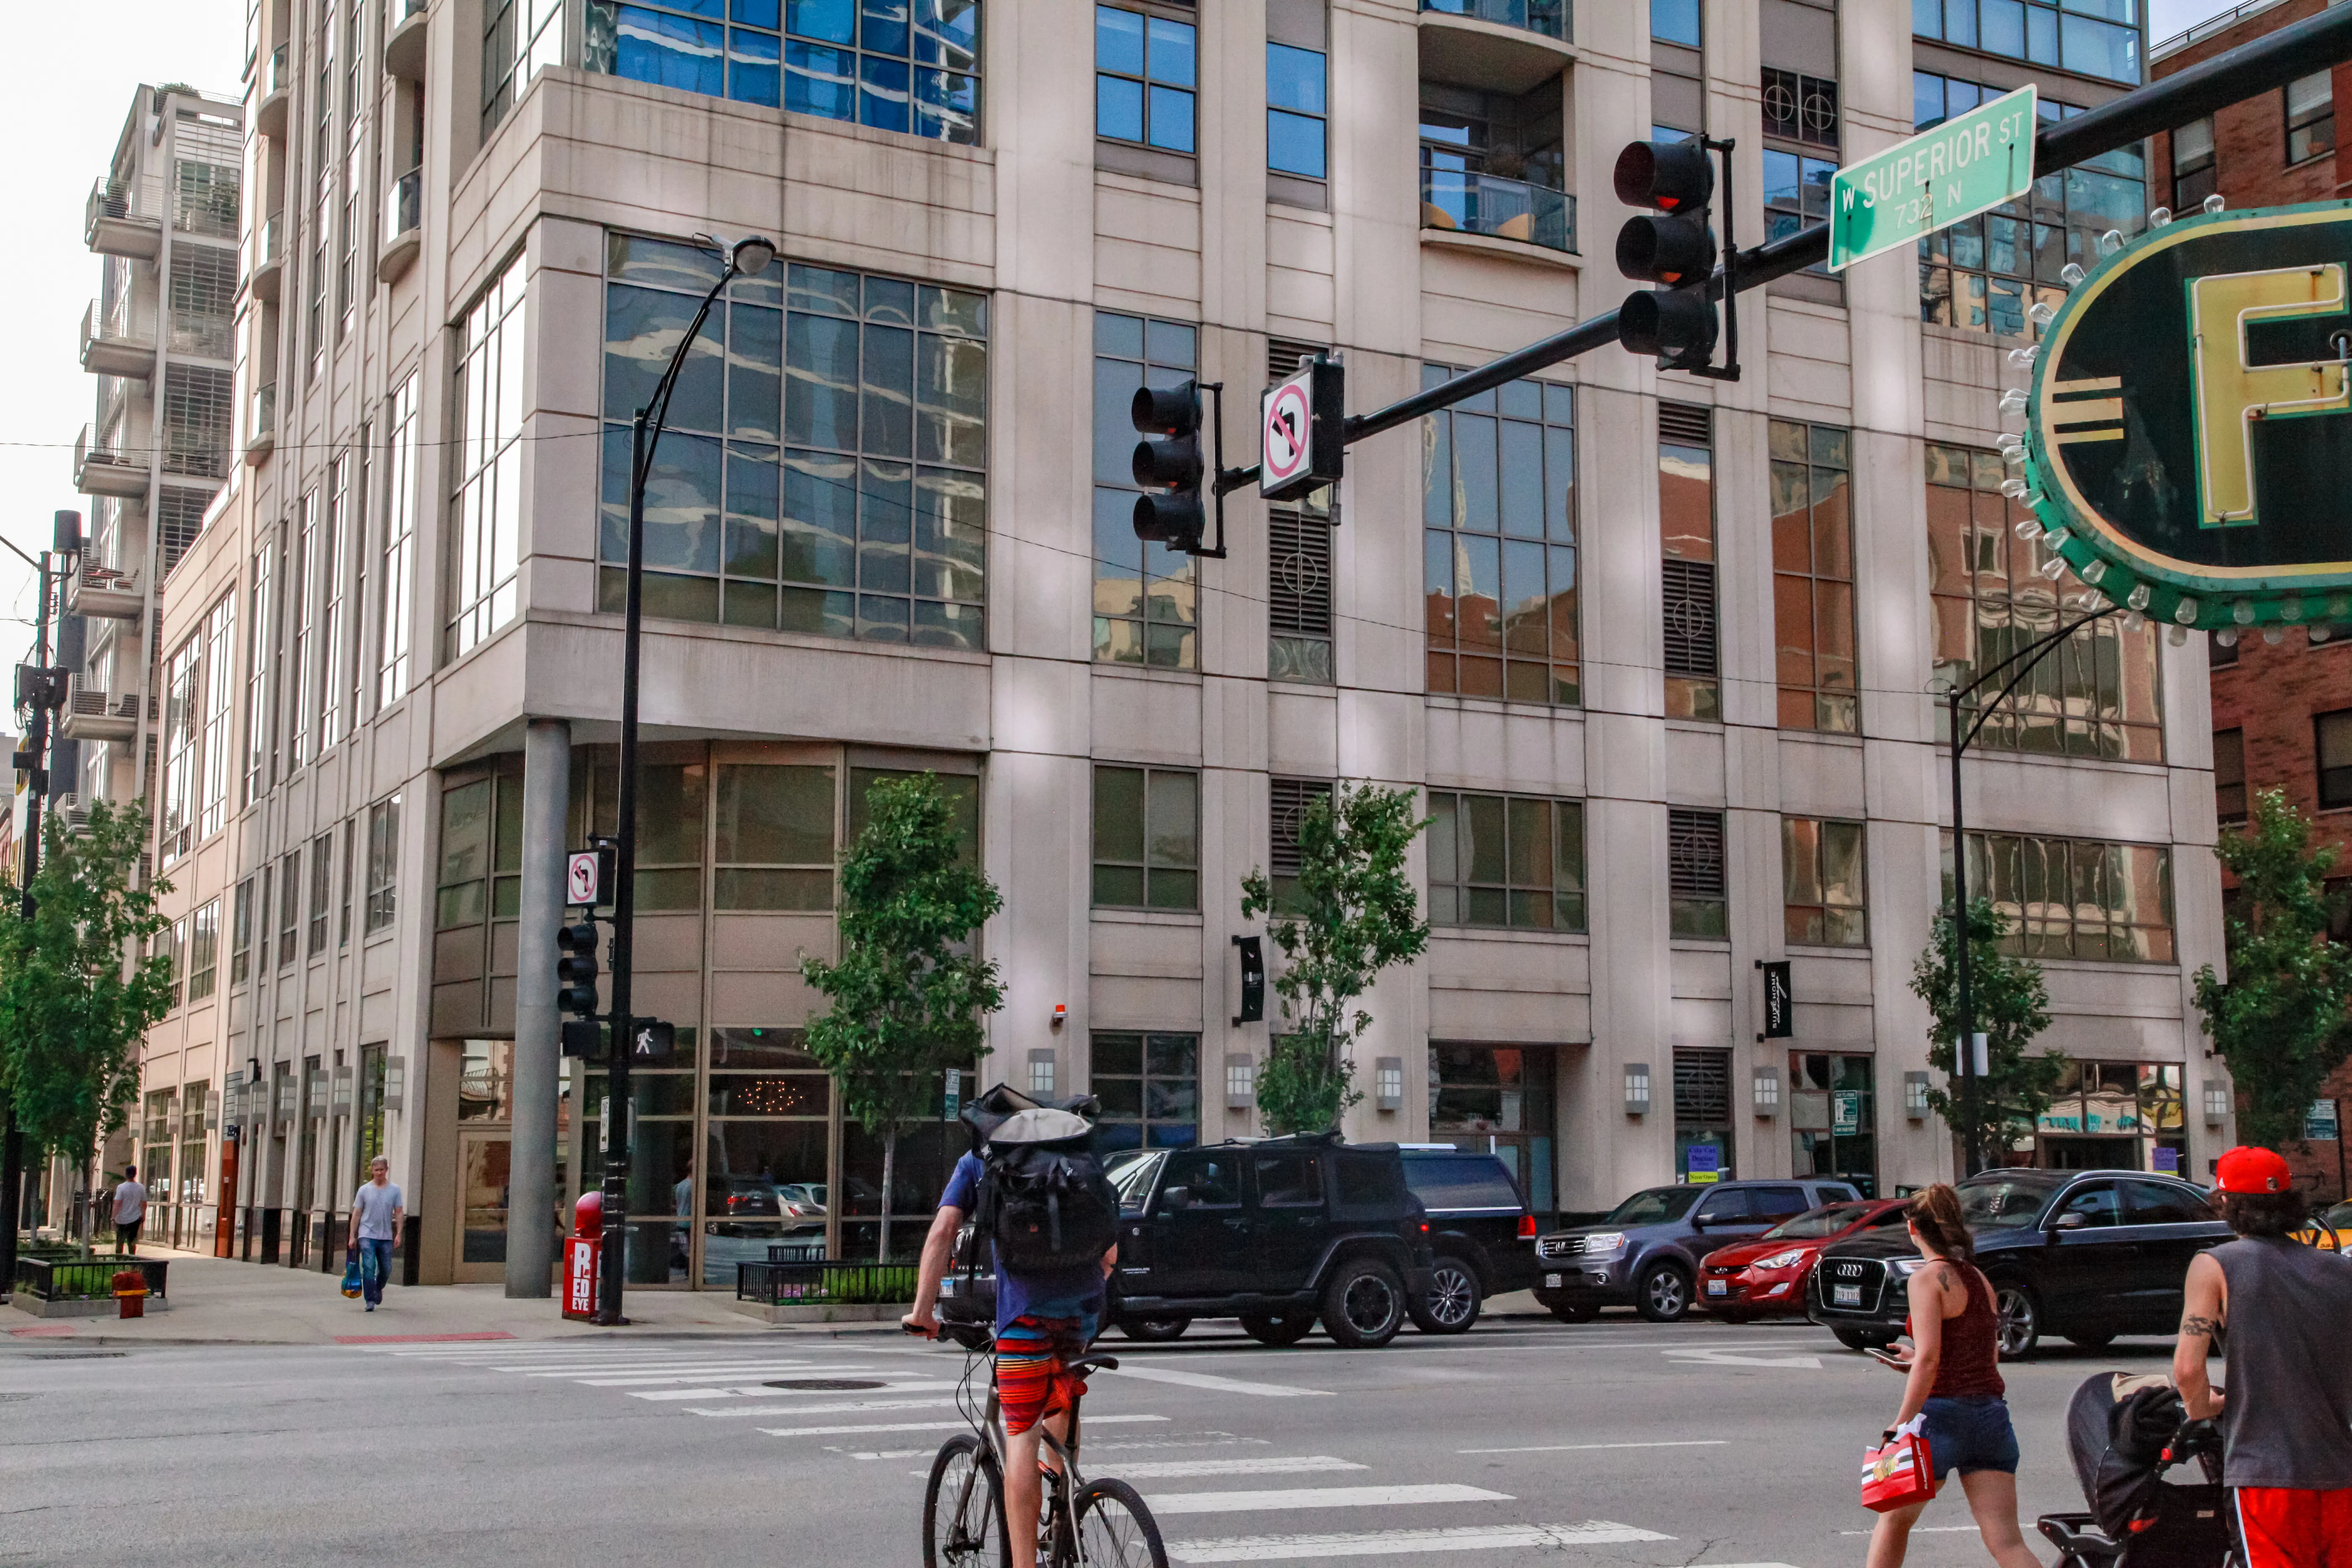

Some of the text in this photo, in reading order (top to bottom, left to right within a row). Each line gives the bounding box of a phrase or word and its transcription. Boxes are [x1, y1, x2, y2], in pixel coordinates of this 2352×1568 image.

[1842, 111, 2023, 212] W SUPERIOR ST
[1894, 180, 1962, 229] 732 N
[1900, 1190, 1905, 1199] P
[573, 1278, 589, 1298] ED
[572, 1297, 589, 1311] EYE
